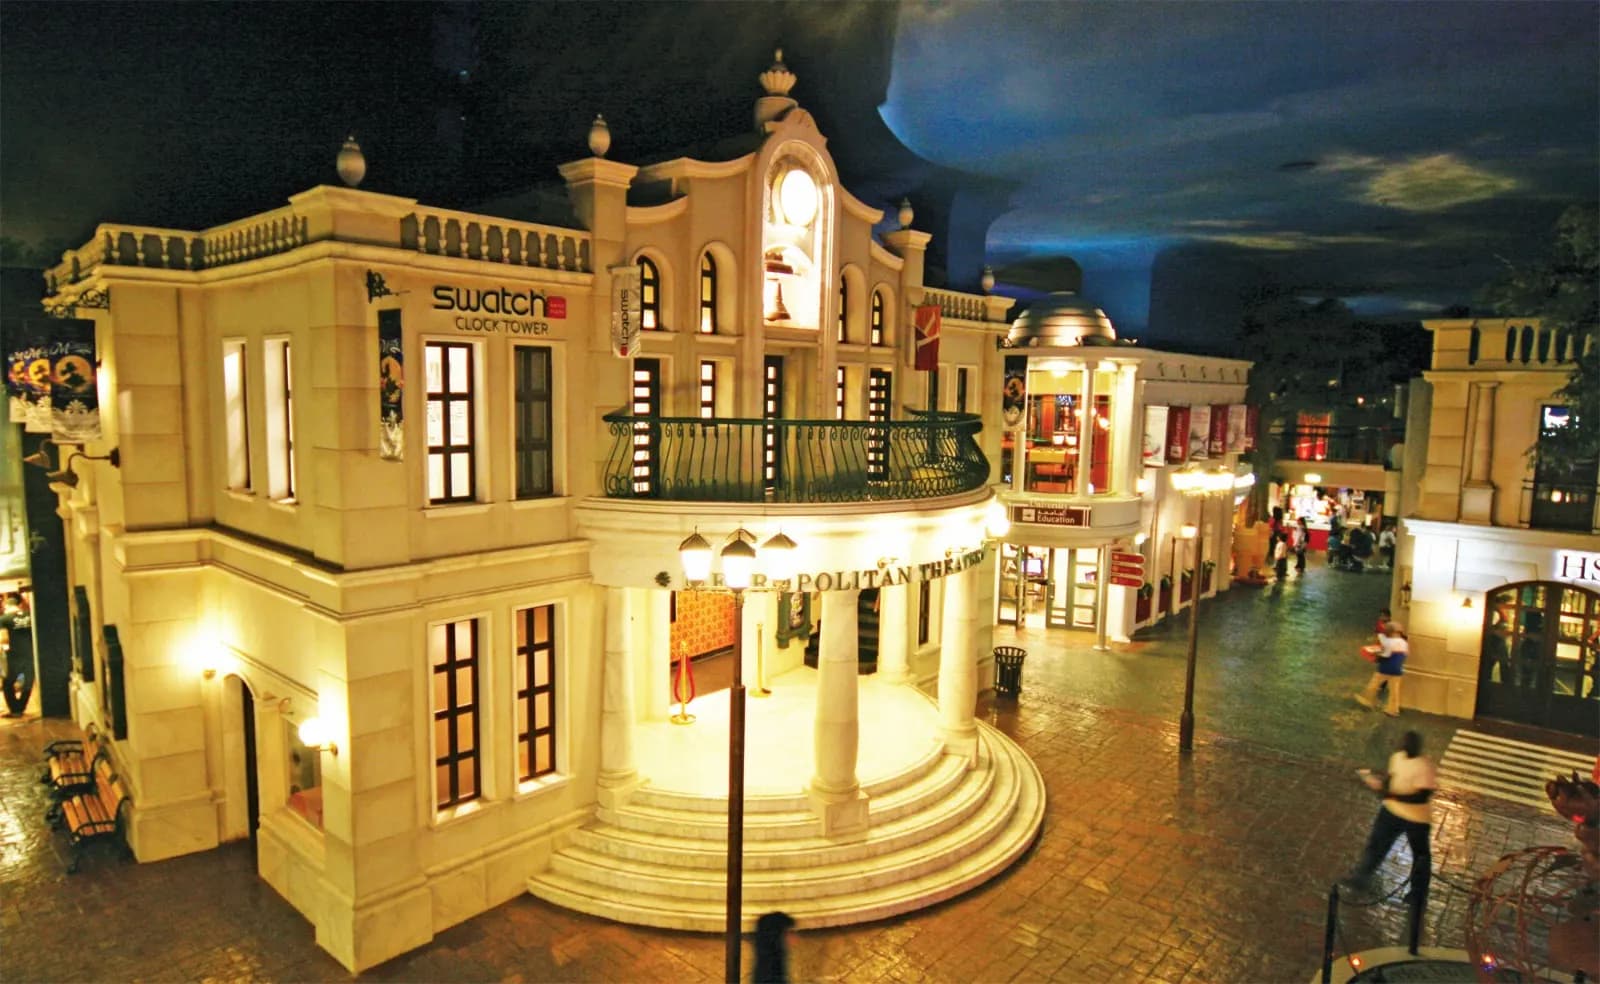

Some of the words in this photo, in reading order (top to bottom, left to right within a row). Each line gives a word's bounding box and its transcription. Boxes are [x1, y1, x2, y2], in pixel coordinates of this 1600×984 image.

[433, 285, 547, 317] swatch
[455, 317, 499, 332] CLOCK
[502, 319, 549, 334] TOWER
[621, 289, 629, 346] swatch
[1037, 515, 1075, 525] Education
[684, 565, 913, 593] ERPOLITAN
